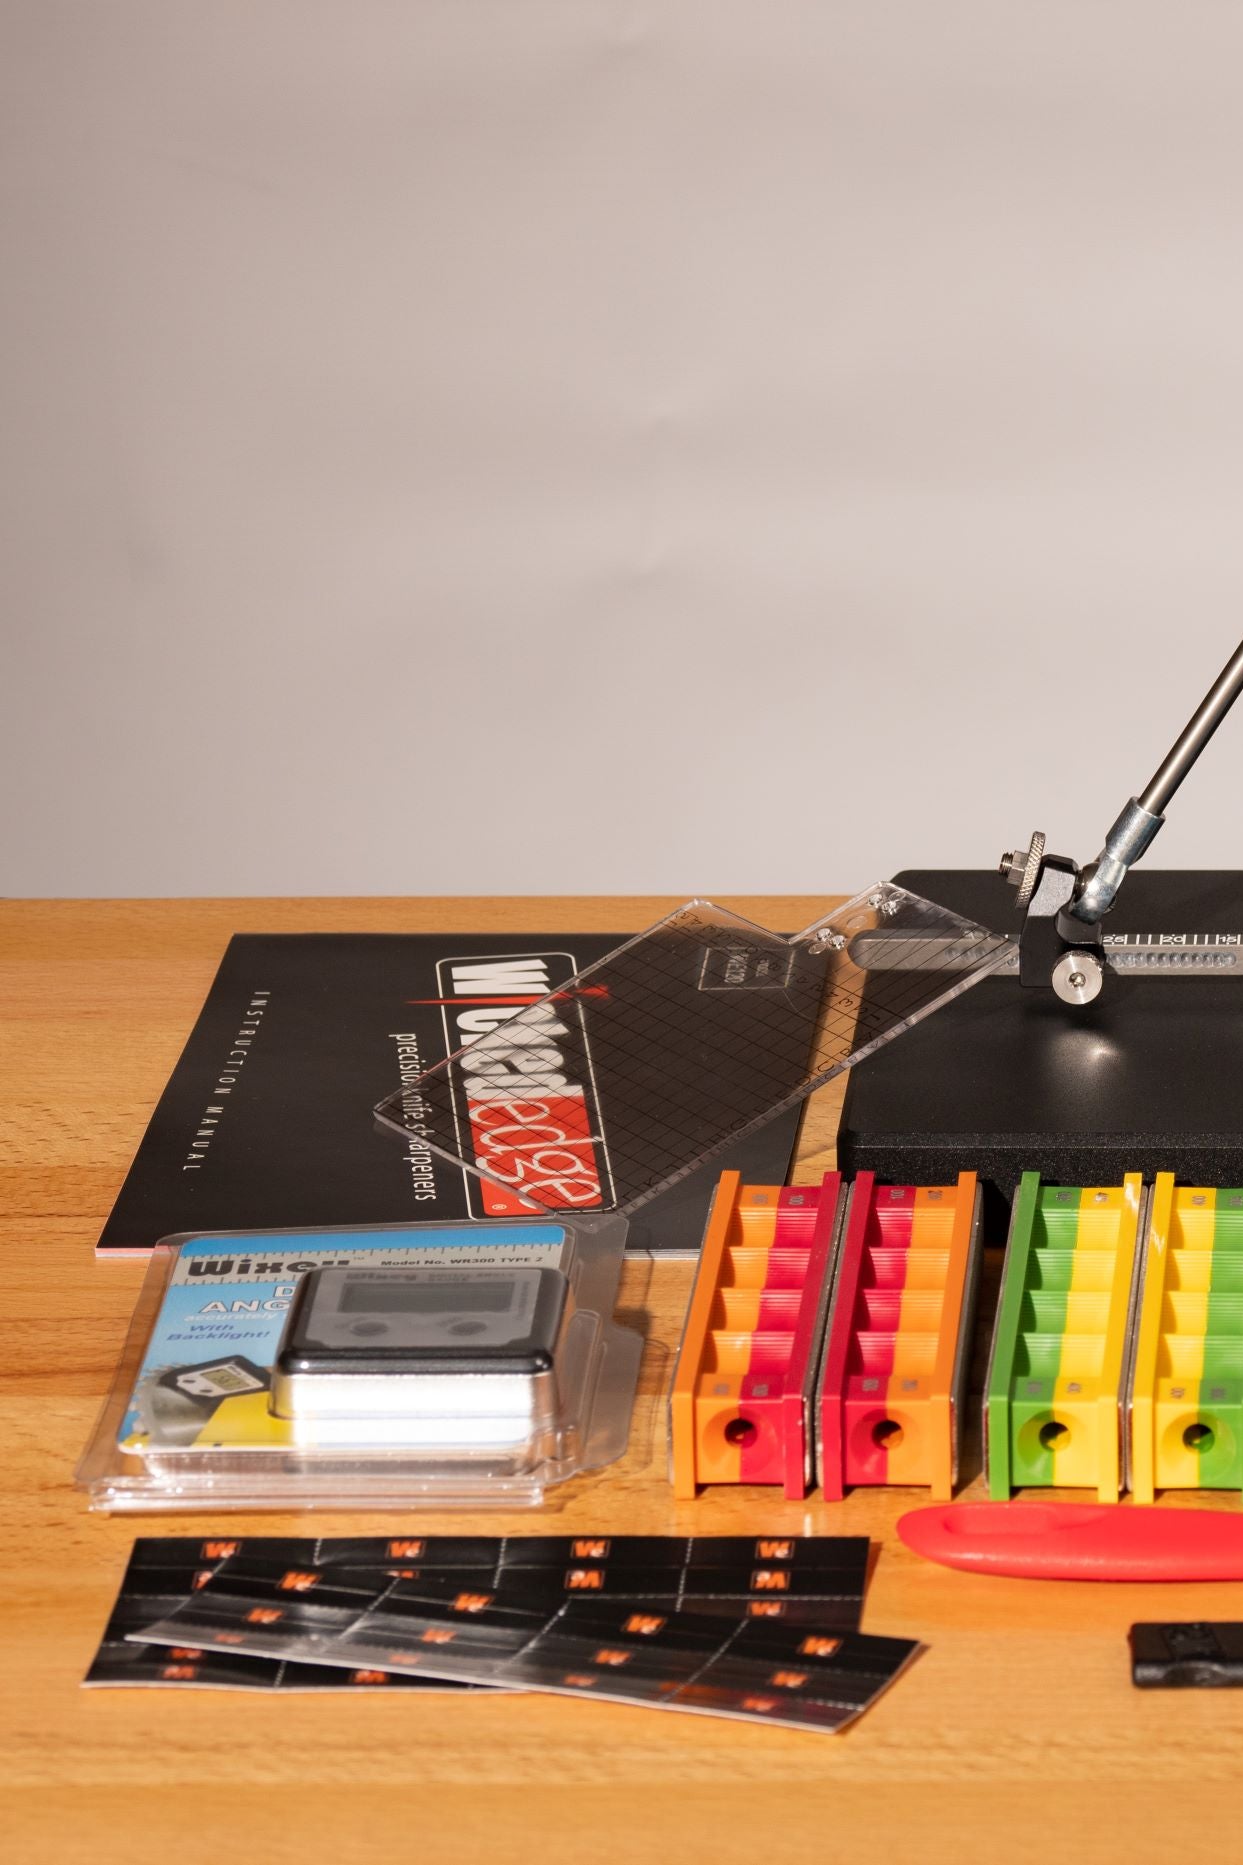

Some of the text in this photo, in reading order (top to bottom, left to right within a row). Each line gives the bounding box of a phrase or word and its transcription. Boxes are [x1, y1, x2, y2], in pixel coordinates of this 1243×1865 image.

[182, 991, 271, 1170] INSTRUCTION MANUAL
[402, 1088, 432, 1120] knife
[166, 1330, 271, 1341] Backlight!
